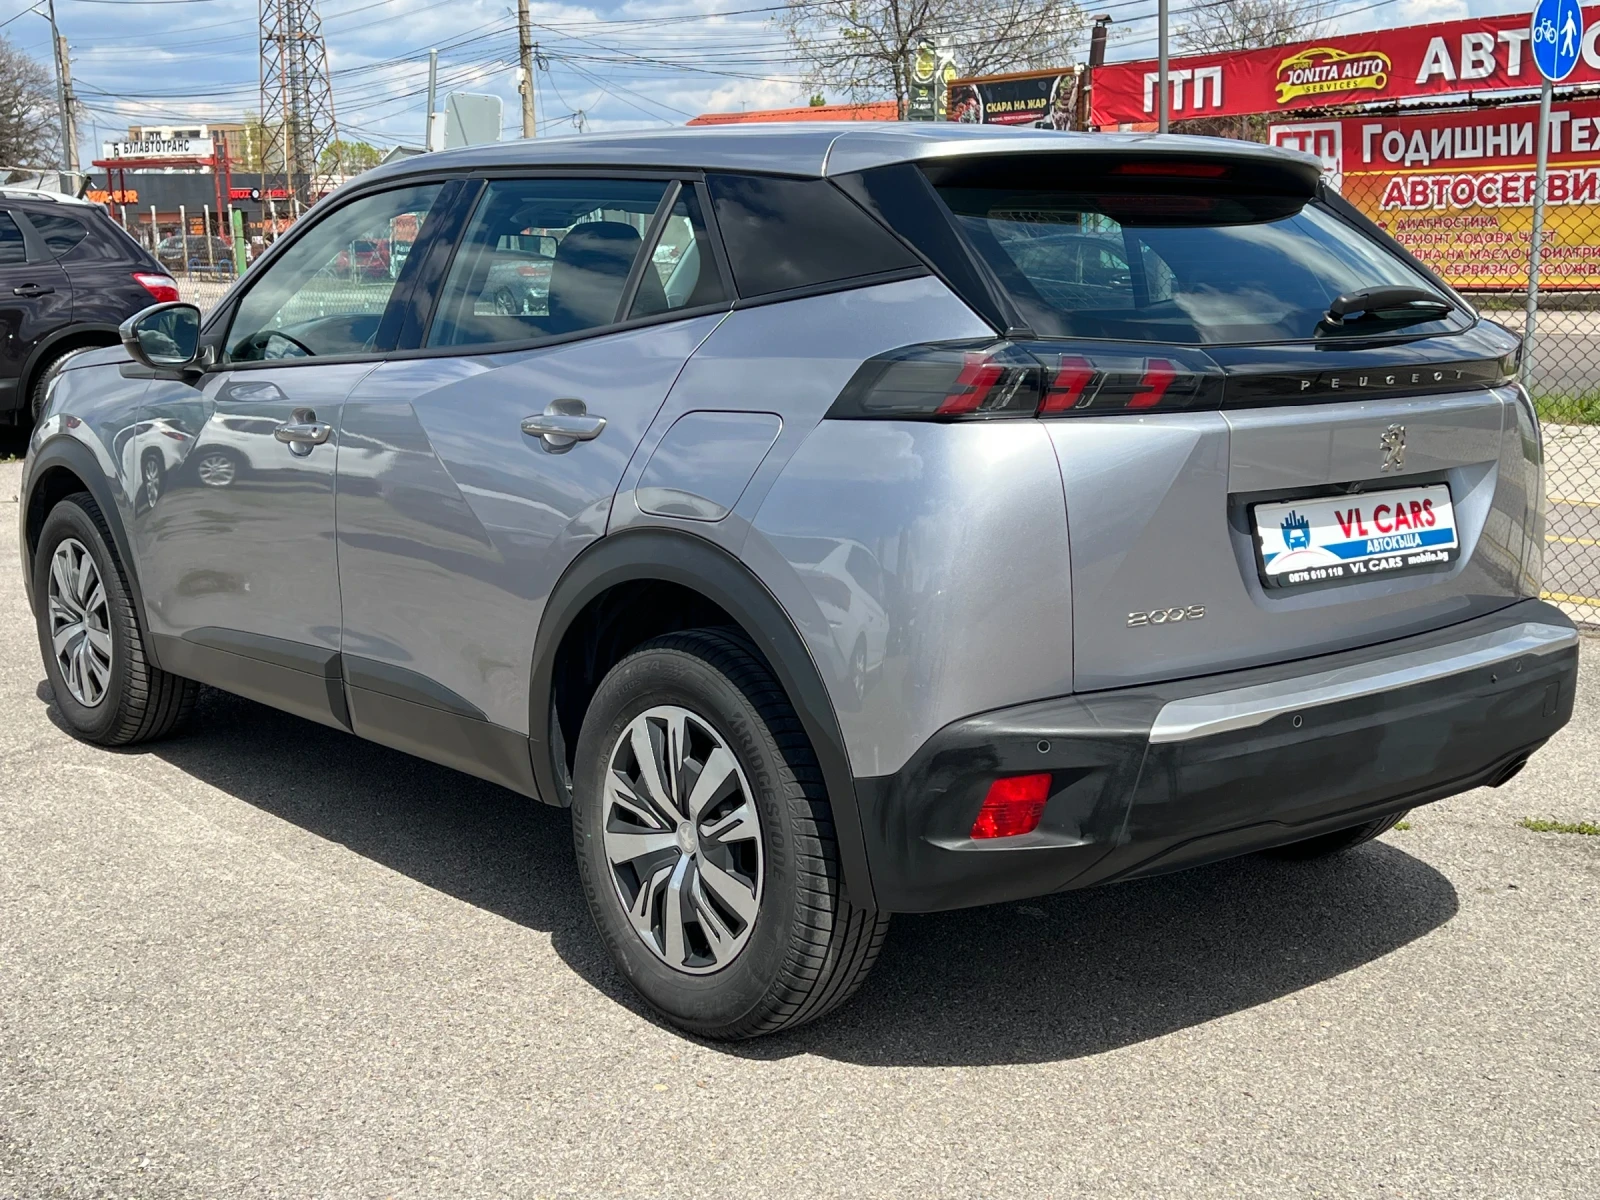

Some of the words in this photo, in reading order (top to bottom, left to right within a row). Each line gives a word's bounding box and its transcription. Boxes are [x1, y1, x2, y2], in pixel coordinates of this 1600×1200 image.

[1286, 65, 1339, 85] JONITA
[1342, 59, 1383, 79] AUTO
[1143, 65, 1222, 113] ГТП
[1305, 80, 1358, 93] SERVICES
[986, 101, 1013, 113] СКАРА
[1014, 100, 1026, 110] НА
[1027, 98, 1047, 109] ЖАР
[124, 139, 190, 154] БУЛАВТОТРАНС
[1380, 169, 1600, 210] АВТОСЕРВИ
[1396, 216, 1499, 231] ДИАГНОСТИКА
[1395, 232, 1450, 246] РЕМОНТ
[1455, 231, 1514, 246] ХОДОВА
[1446, 248, 1465, 260] НА
[1469, 247, 1522, 260] МАСЛО
[1445, 263, 1519, 276] СЕРВИЗНО
[1301, 370, 1463, 391] PEUGEOT
[1334, 507, 1369, 539] VL
[1373, 498, 1437, 533] CARS
[1366, 532, 1423, 554] АВТОКЪЩА
[1289, 571, 1310, 583] 0876
[1310, 568, 1327, 580] 619
[1327, 566, 1344, 577] 118
[1349, 562, 1367, 574] VL
[1368, 557, 1403, 571] CARS
[1407, 551, 1449, 564] mobile.bg
[1126, 603, 1206, 628] 2008
[728, 711, 788, 884] BRIDGESTONE
